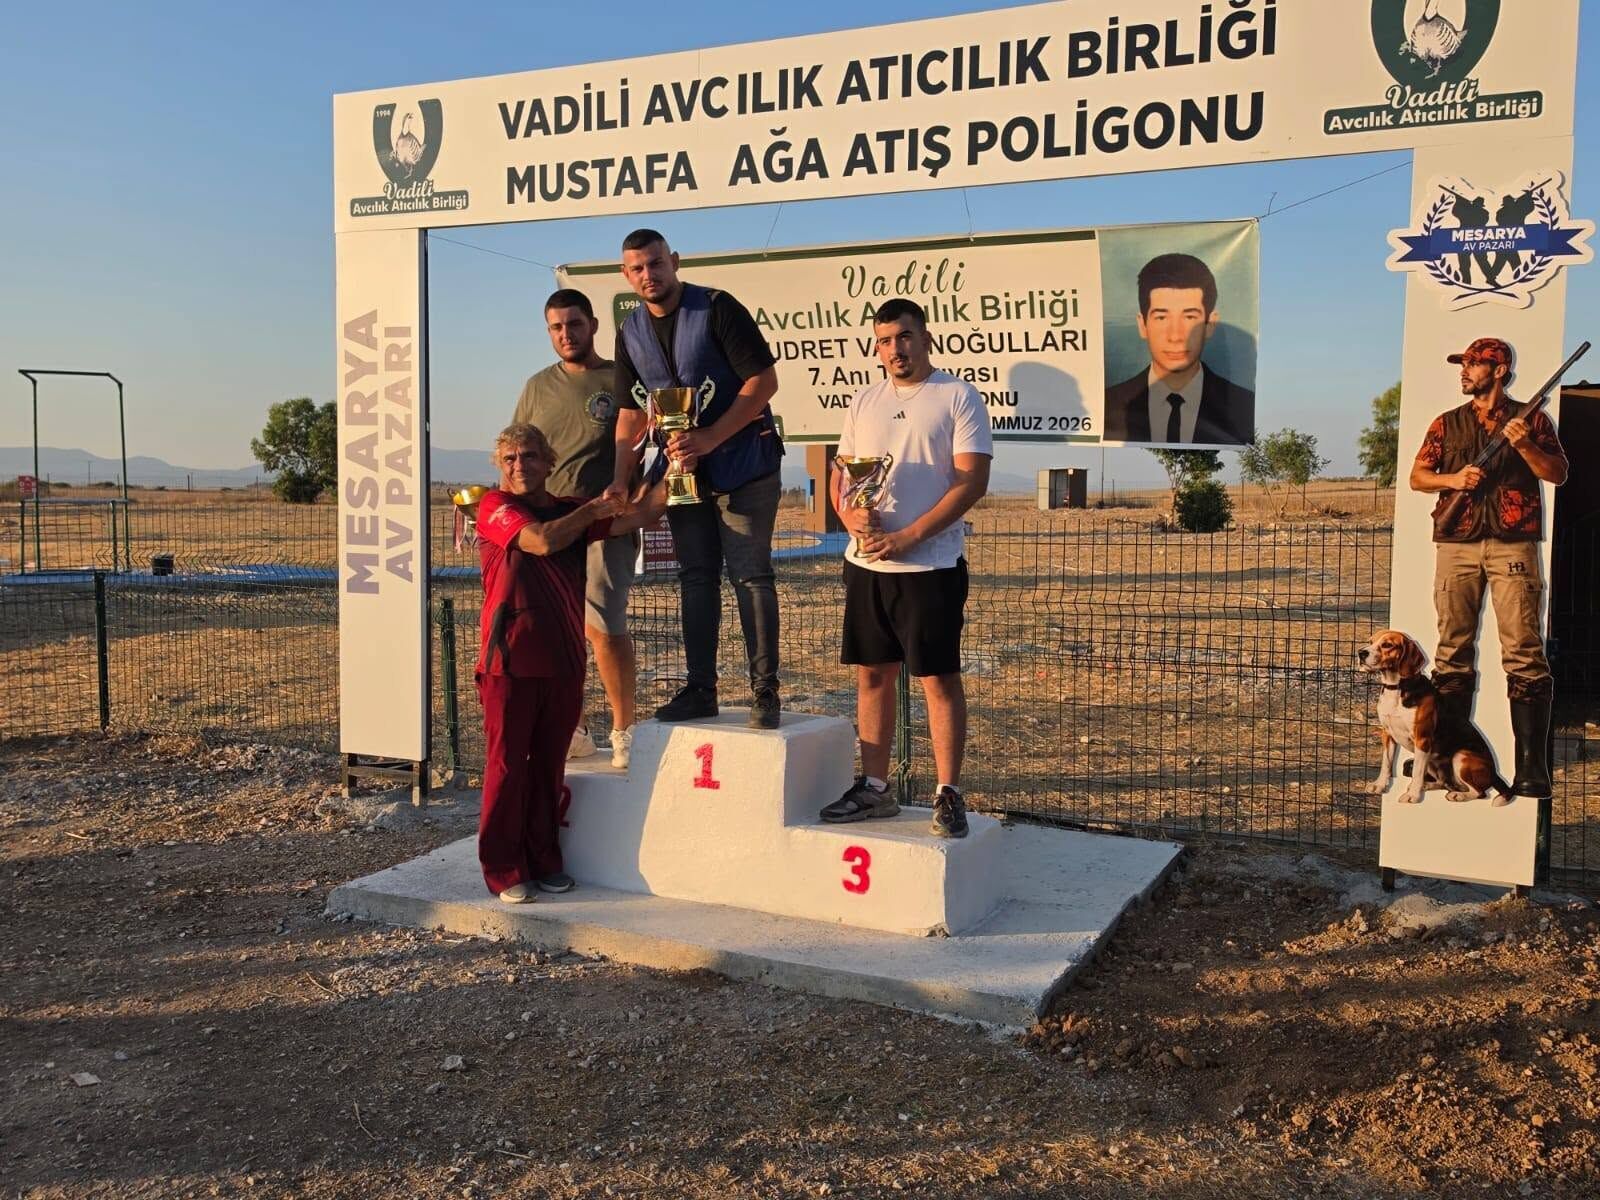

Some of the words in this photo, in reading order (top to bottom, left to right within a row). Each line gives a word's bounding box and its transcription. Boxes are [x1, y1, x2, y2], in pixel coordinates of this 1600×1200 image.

[499, 78, 629, 140] VADİLİ
[643, 64, 824, 126] AVCILIK
[836, 36, 1051, 105] ATICILIK
[1067, 0, 1277, 79] BİRLİĞİ
[1386, 79, 1480, 109] Vadili
[1328, 110, 1394, 132] Avcılık
[1399, 104, 1469, 125] Atıcılık
[1475, 97, 1538, 119] Birliği
[507, 151, 698, 205] MUSTAFA
[728, 126, 830, 187] AĞA
[842, 125, 951, 178] ATIŞ
[967, 91, 1265, 166] POLİGONU
[352, 201, 389, 215] Avcılık
[391, 198, 430, 212] Atıcılık
[432, 194, 467, 209] Birliği
[384, 180, 434, 200] Vadili
[1451, 227, 1527, 242] MESARYA
[1462, 242, 1477, 251] AV
[1478, 240, 1515, 251] PAZARI
[841, 258, 966, 298] Vadili
[755, 301, 853, 331] Avcılık
[859, 294, 971, 327] Aılık
[980, 289, 1079, 328] Birliği
[774, 338, 849, 361] DRET
[808, 367, 826, 386] 7.
[832, 365, 870, 386] Anı
[384, 326, 413, 506] PAZARI
[991, 416, 1043, 431] MMUZ
[1048, 415, 1092, 431] 2026
[343, 308, 380, 595] MESARYA
[385, 518, 413, 583] AV
[693, 742, 720, 790] 1
[842, 845, 872, 895] 3
